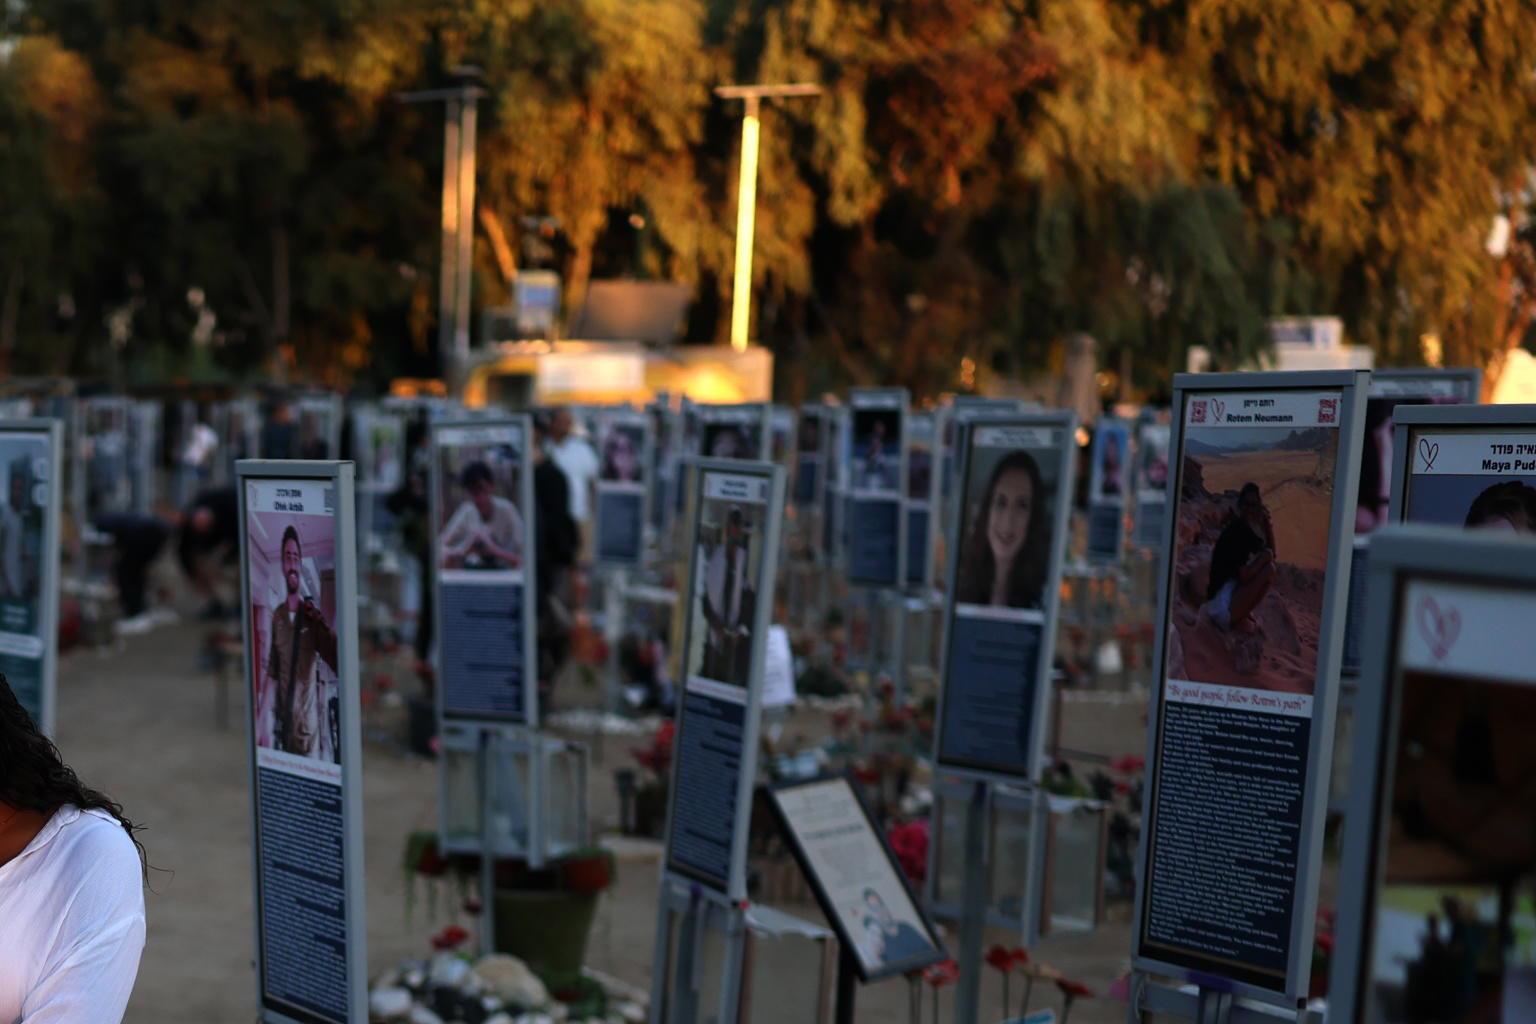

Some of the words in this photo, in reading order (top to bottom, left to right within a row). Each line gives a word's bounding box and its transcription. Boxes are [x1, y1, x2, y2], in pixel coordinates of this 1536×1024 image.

[1226, 413, 1252, 422] Rotem
[1254, 413, 1293, 423] Neumann
[1490, 444, 1514, 455] פודר
[1482, 459, 1511, 473] Maya
[1514, 459, 1536, 470] Pud
